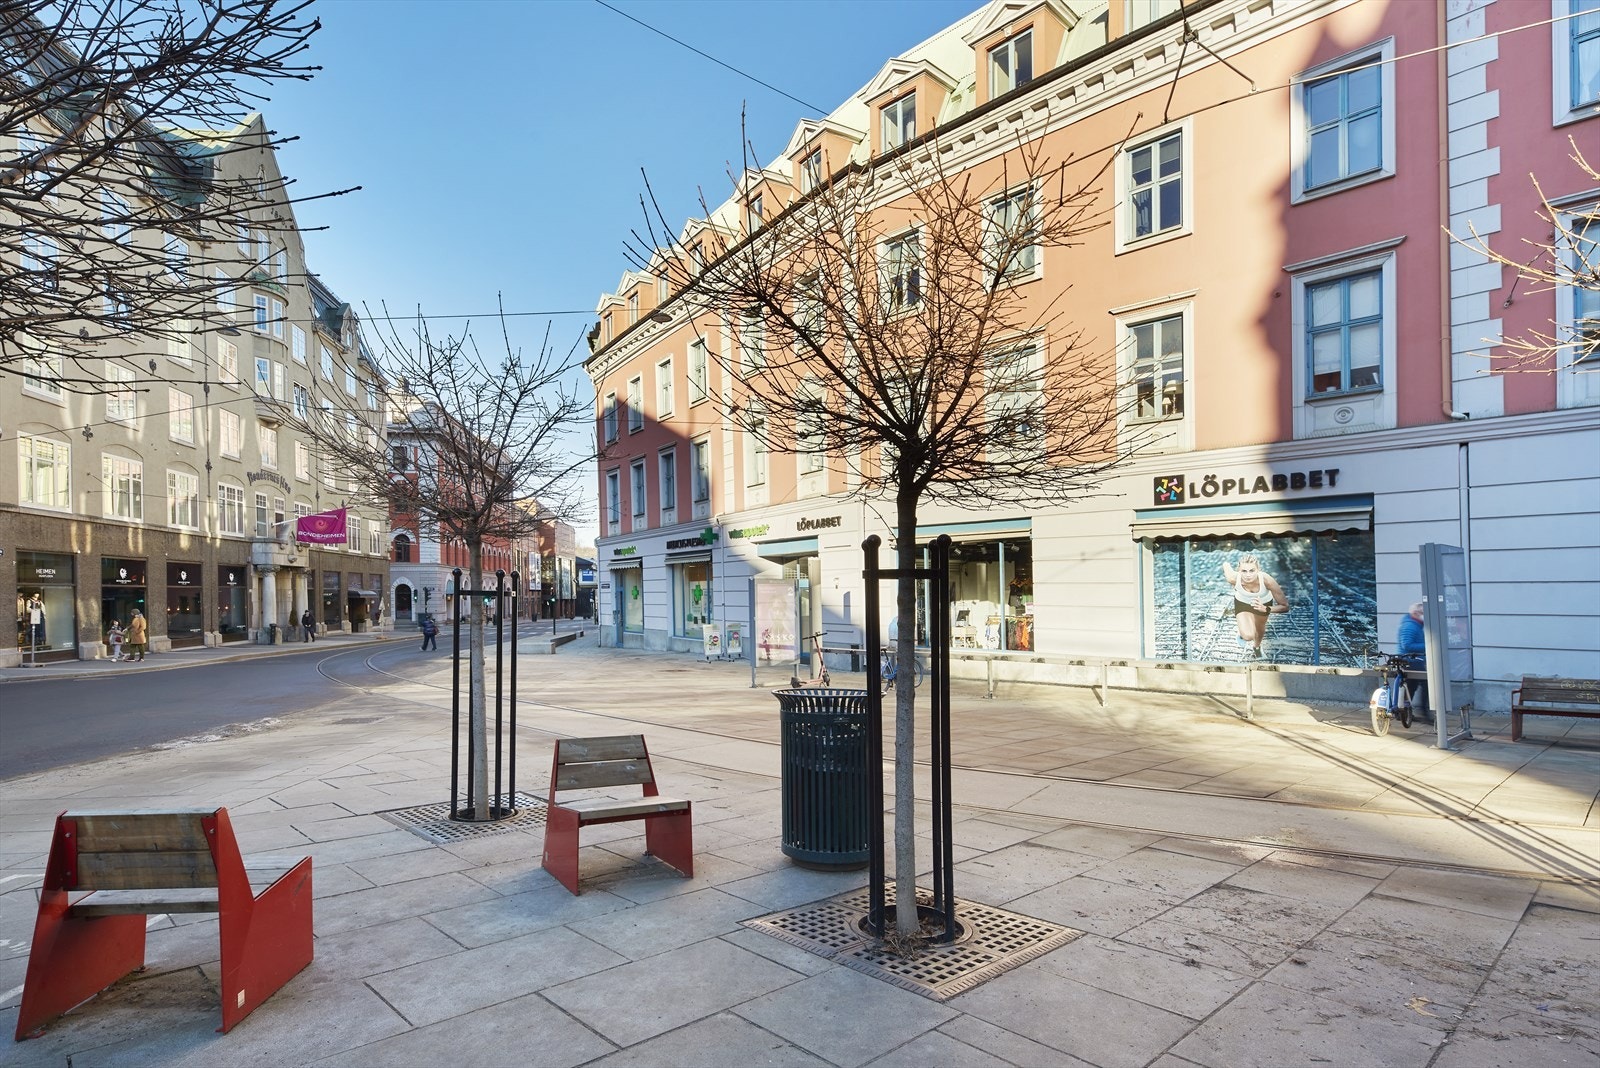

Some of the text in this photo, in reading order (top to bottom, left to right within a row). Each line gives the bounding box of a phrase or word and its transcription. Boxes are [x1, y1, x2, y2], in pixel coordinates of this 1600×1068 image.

[1188, 468, 1340, 499] LÖPLABBET
[796, 515, 842, 531] LÖPLABBET
[298, 530, 346, 539] BONDEHEIMEN
